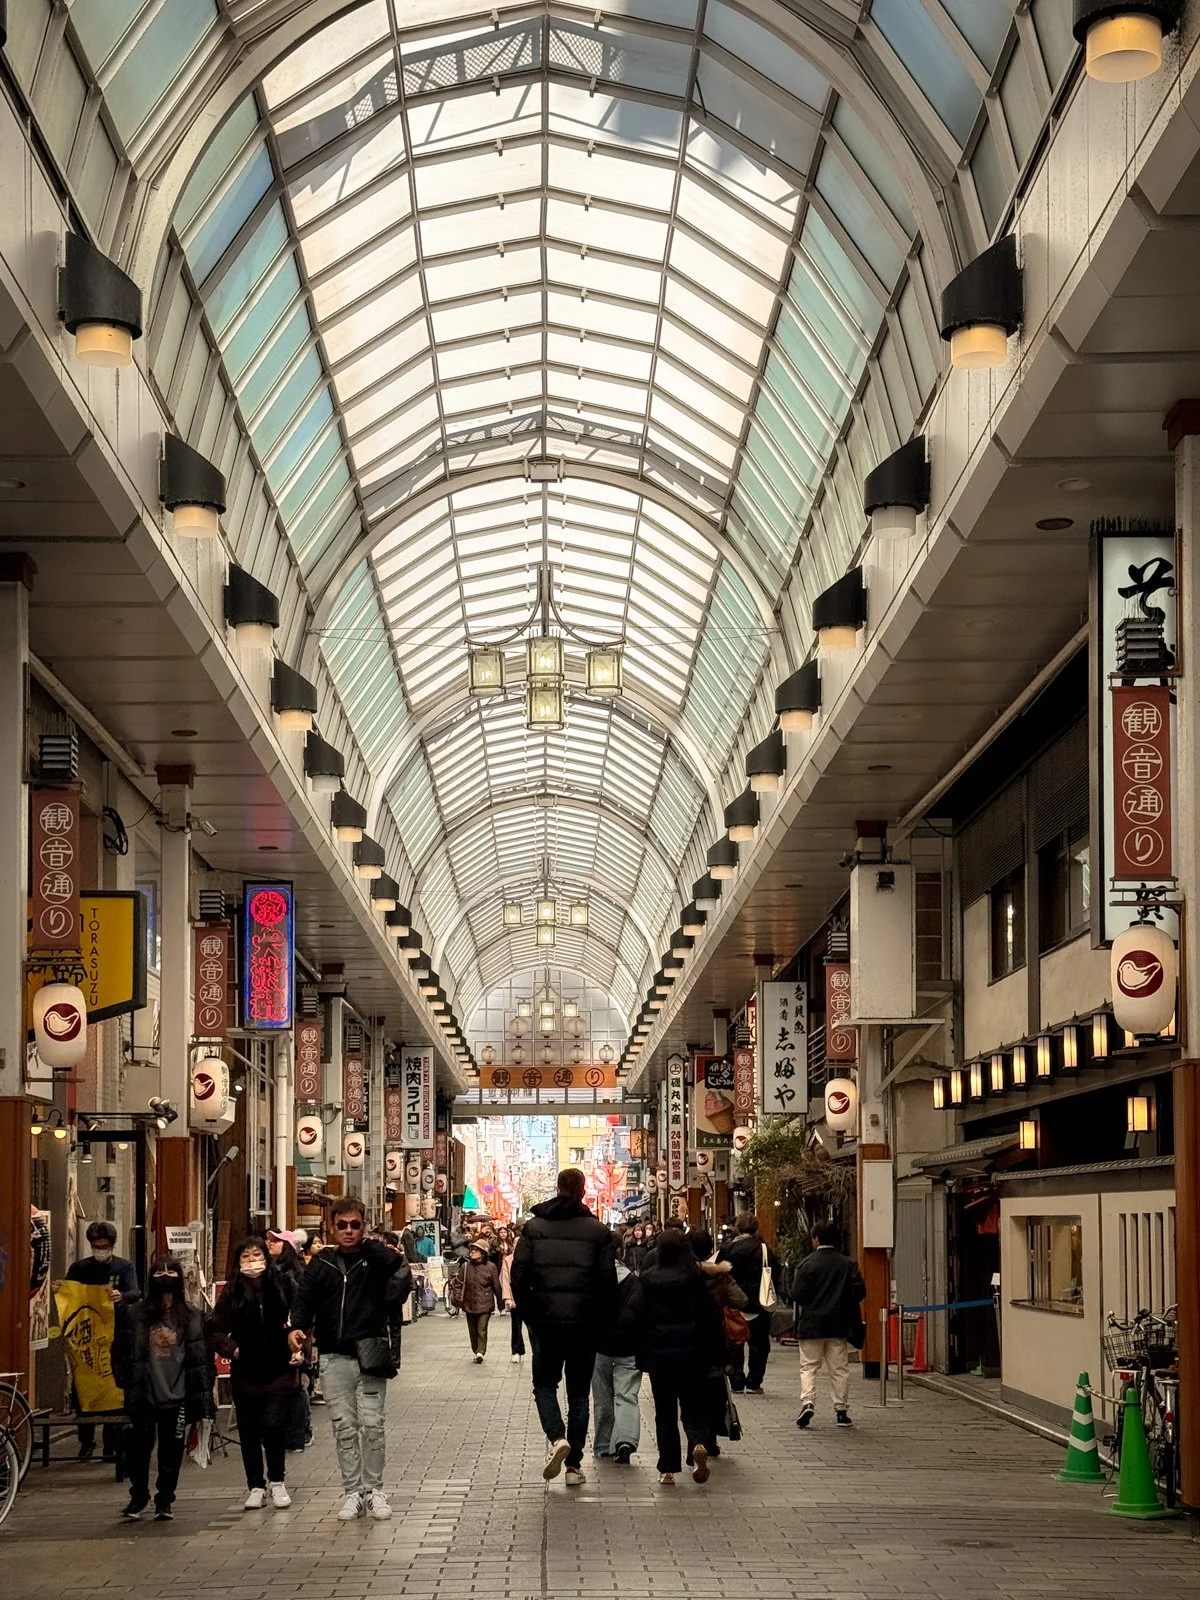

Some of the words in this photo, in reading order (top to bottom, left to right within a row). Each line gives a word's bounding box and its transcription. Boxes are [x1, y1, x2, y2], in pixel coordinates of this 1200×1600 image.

[1122, 701, 1163, 866] 観音通り
[40, 803, 73, 938] 観音通り
[89, 908, 99, 1006] TORASUZU
[200, 935, 223, 1029] 観音通り
[301, 1027, 317, 1095] 観音通り
[347, 1059, 362, 1115] 観音通り
[405, 1057, 421, 1125] 焼肉ライク
[491, 1068, 604, 1088] 観音通り
[737, 1053, 751, 1109] 観音通り
[671, 1078, 681, 1125] 磯丸水産
[670, 1130, 682, 1181] 24時間営業
